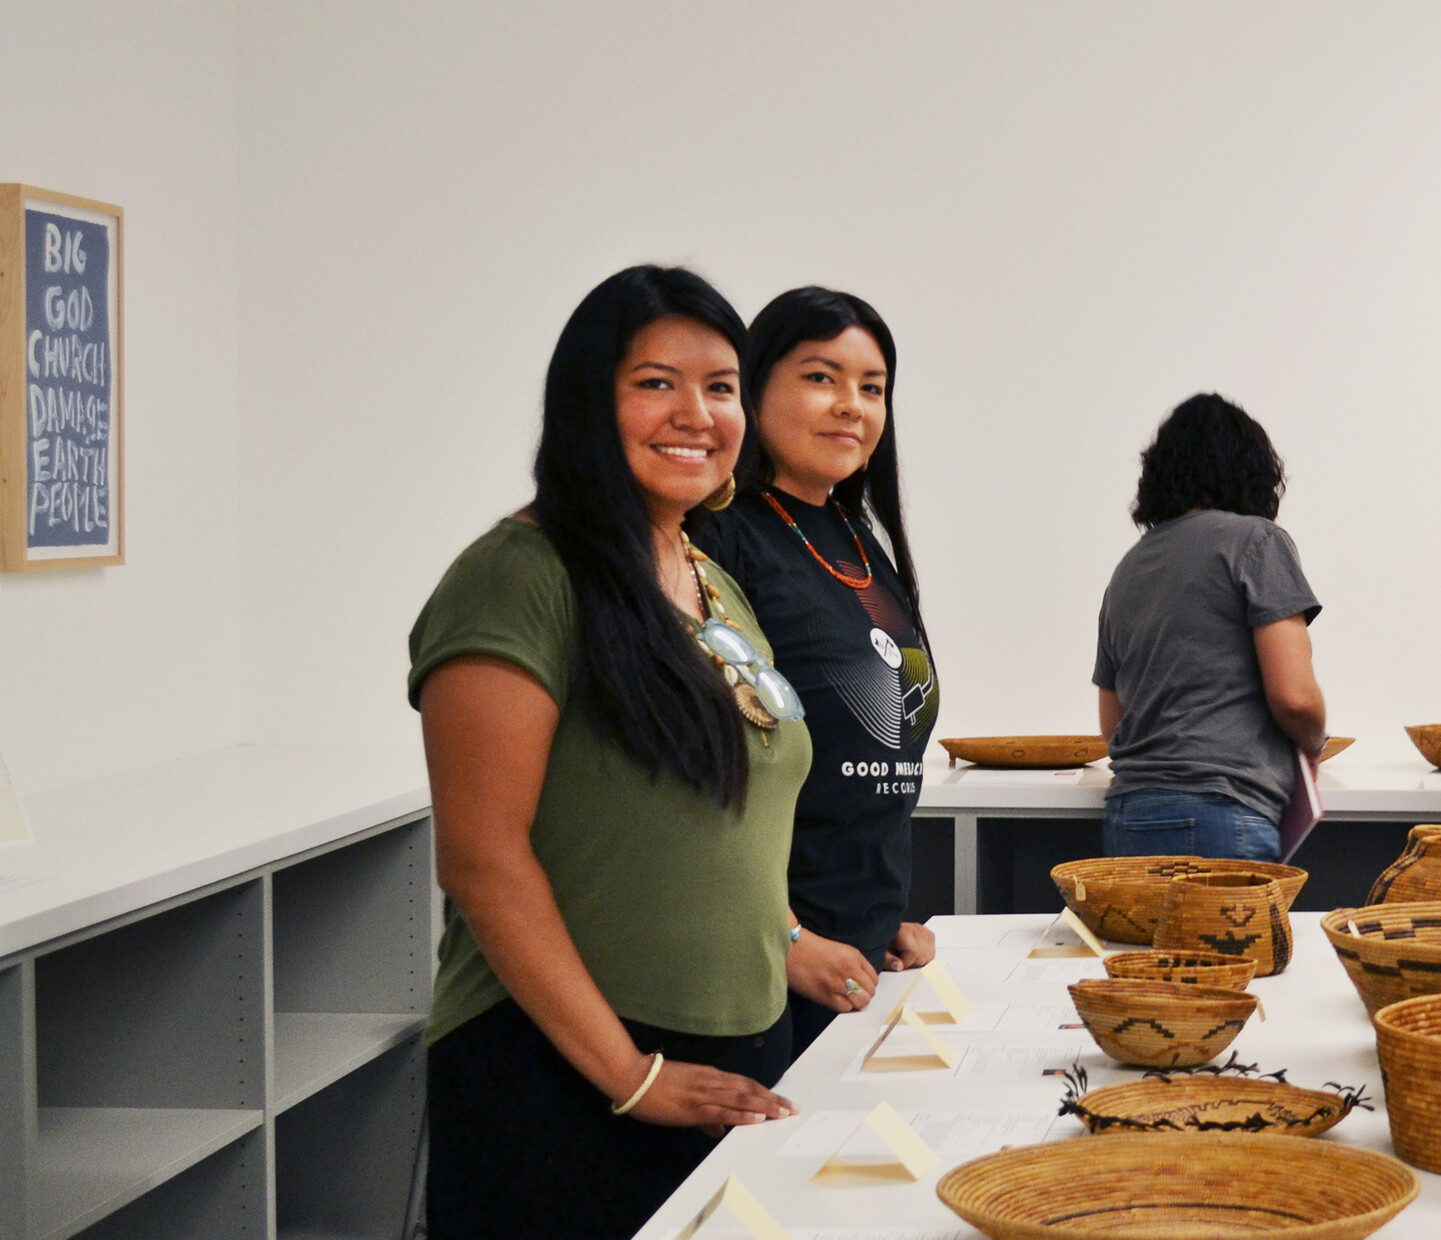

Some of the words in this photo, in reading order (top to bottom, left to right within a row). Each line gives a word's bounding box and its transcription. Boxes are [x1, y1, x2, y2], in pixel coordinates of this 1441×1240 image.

[45, 223, 87, 274] BIG
[46, 286, 94, 332] GOD
[28, 329, 105, 386] CHURCH
[30, 384, 108, 442] DAMAGE
[33, 438, 106, 484] EARTH
[30, 482, 108, 535] PEOPLE
[841, 761, 889, 777] GOOD
